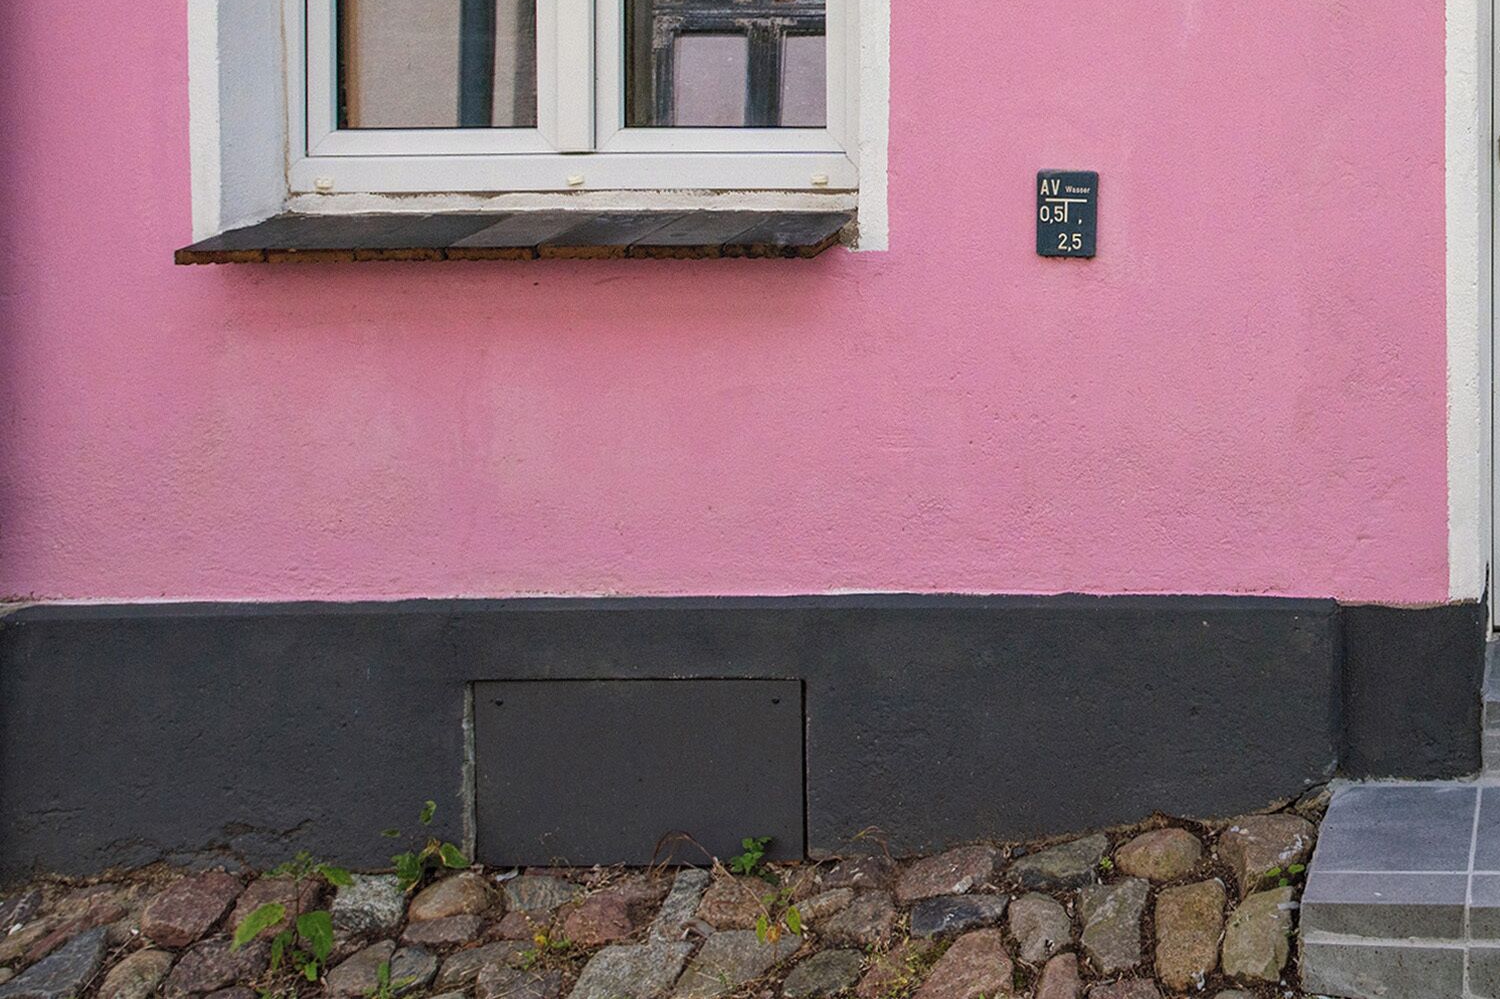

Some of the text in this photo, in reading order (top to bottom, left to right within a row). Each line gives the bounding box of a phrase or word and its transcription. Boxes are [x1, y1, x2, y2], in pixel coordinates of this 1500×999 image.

[1040, 179, 1091, 196] AV Wasser
[1040, 205, 1064, 224] 0,5
[1058, 233, 1082, 252] 2,5
